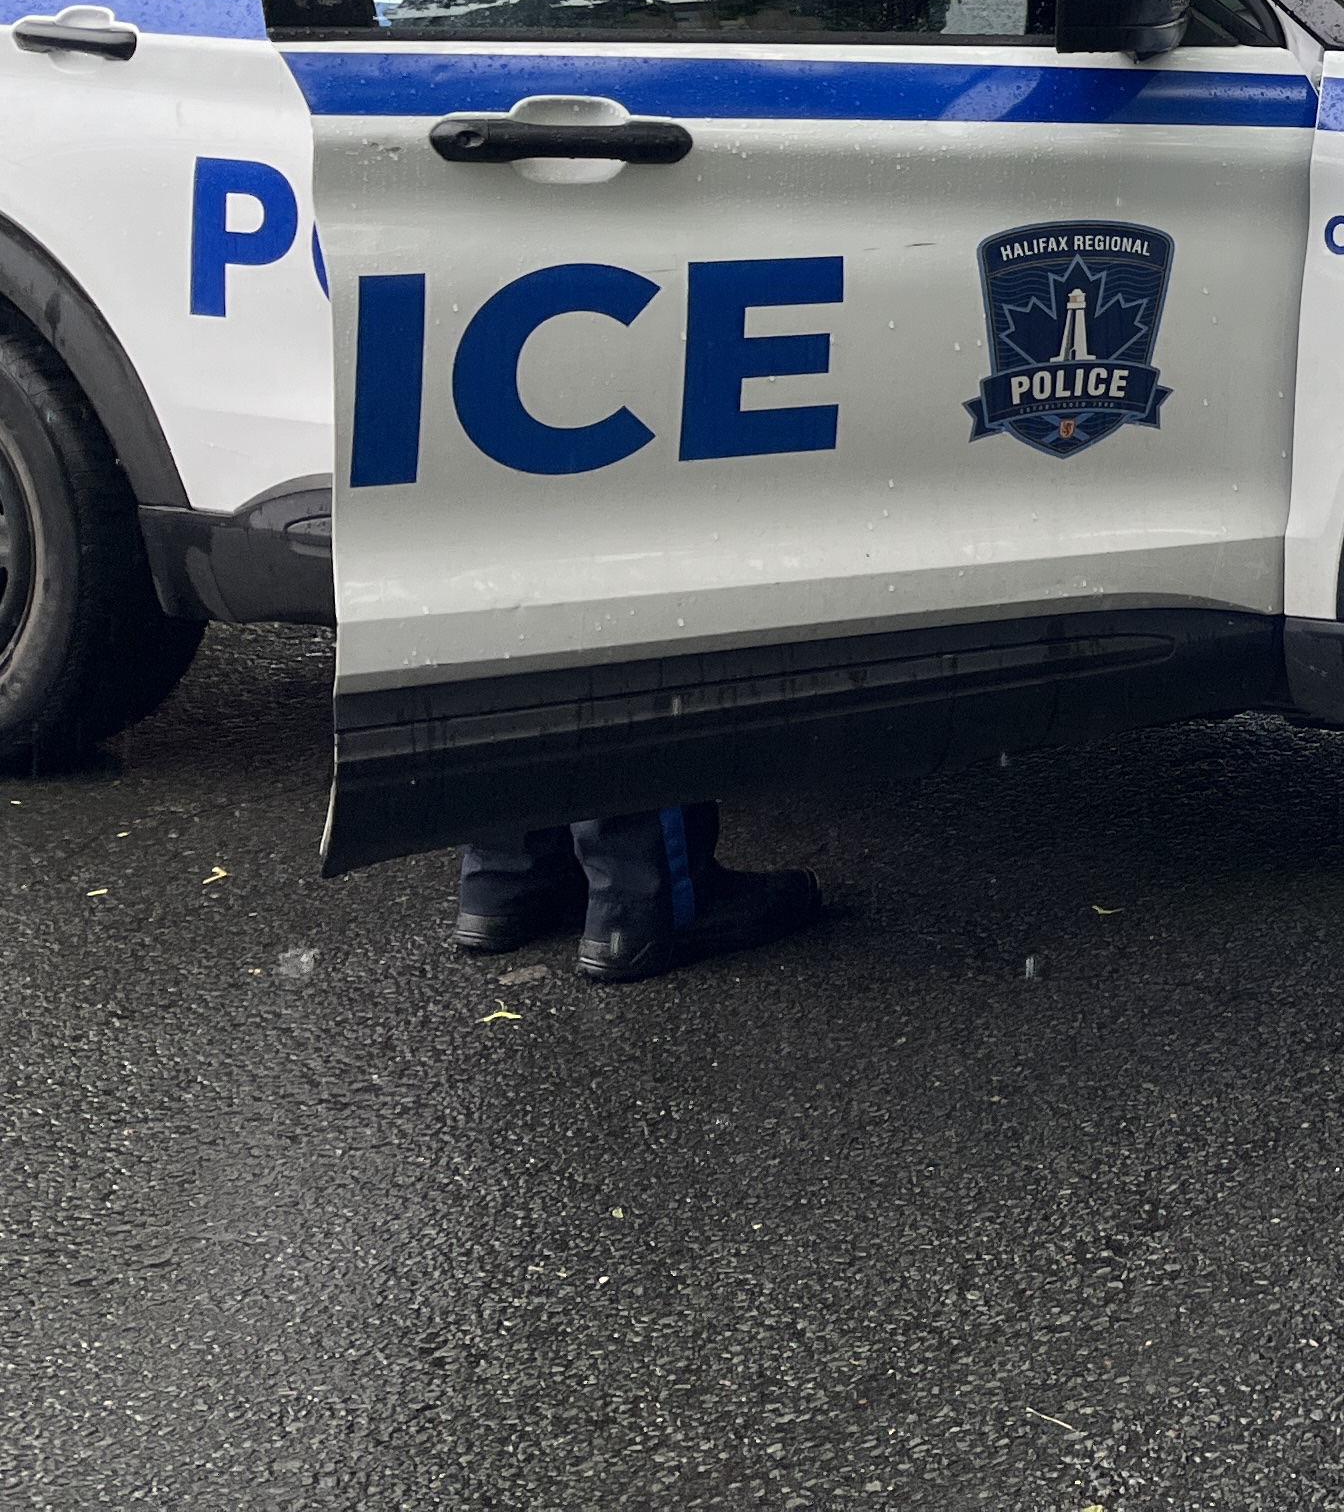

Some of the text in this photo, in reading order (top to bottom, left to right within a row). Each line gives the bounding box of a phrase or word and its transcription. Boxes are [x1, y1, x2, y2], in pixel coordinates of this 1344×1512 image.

[1000, 235, 1151, 261] HALIFAX REGIONAL
[1010, 367, 1129, 405] POLICE
